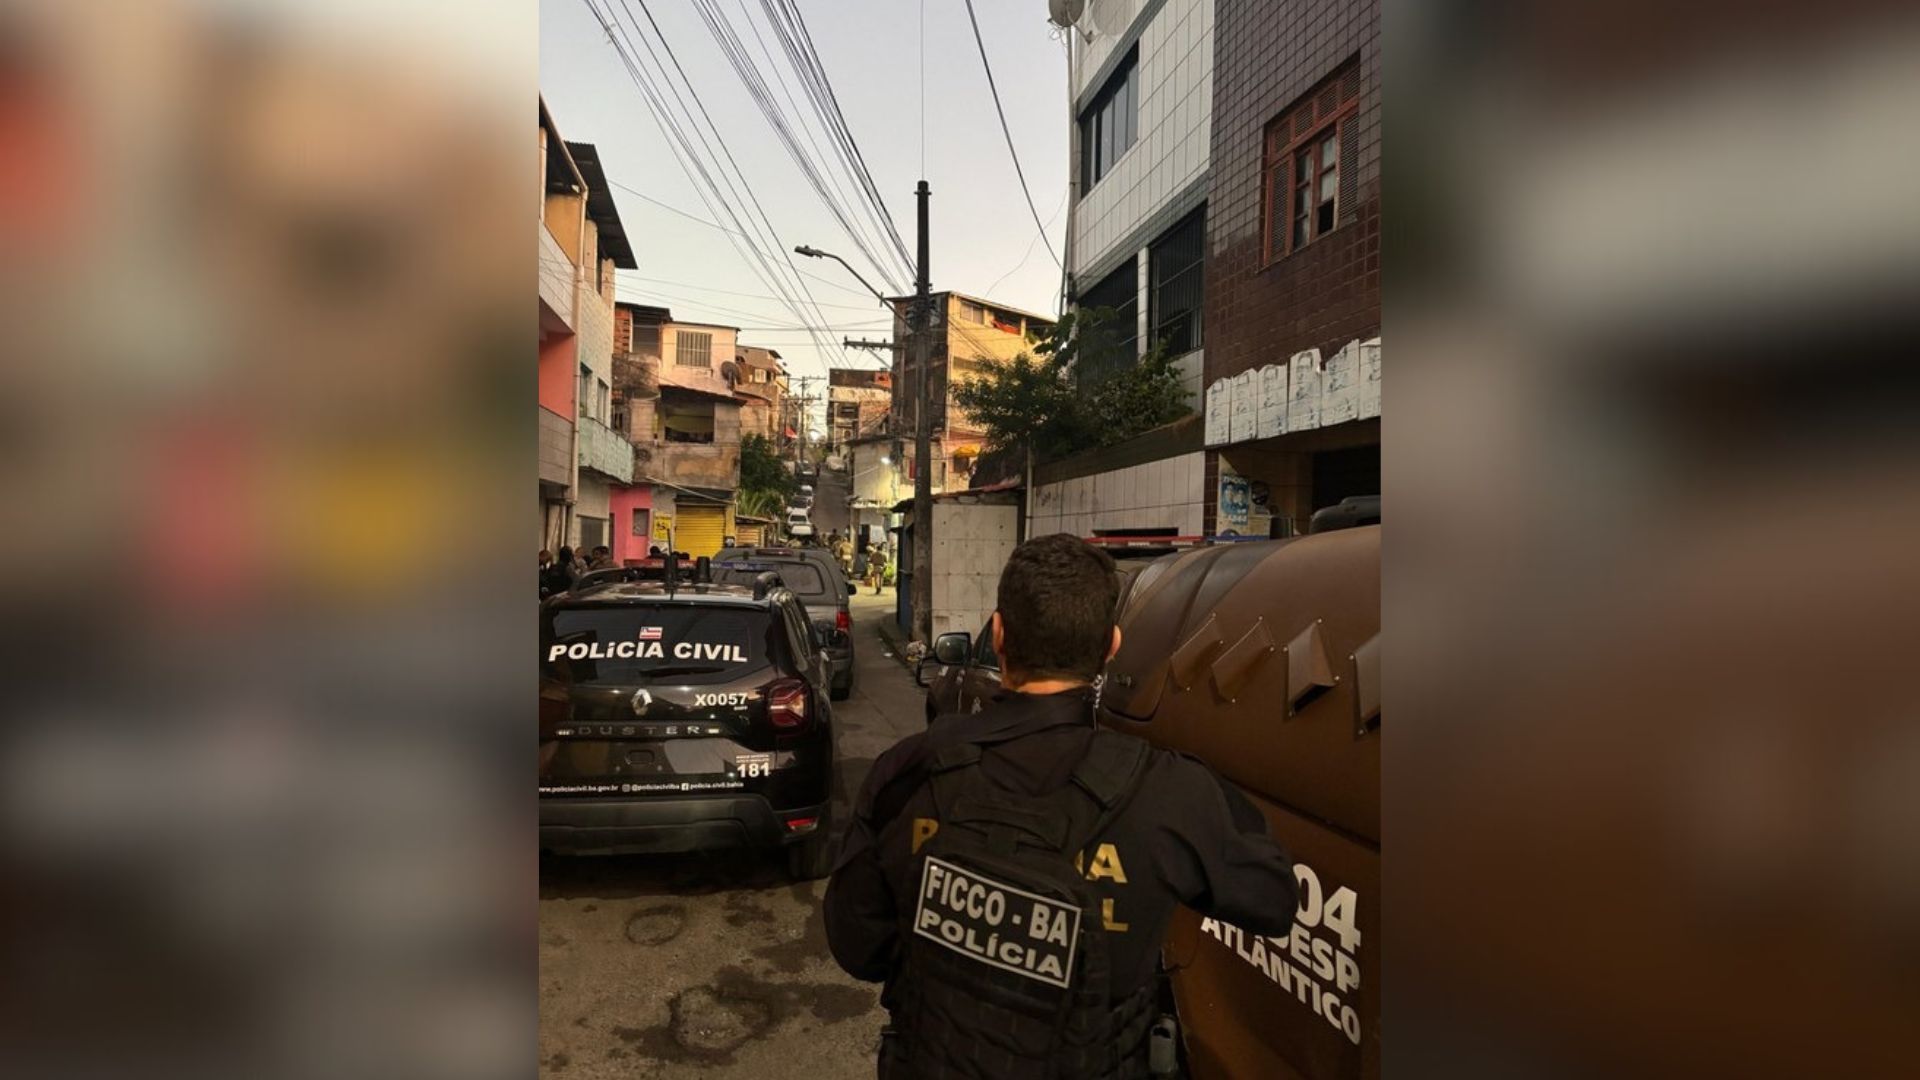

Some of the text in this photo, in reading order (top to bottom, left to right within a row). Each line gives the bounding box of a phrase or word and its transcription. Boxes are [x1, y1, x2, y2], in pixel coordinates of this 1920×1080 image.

[674, 642, 748, 662] CIVIL
[694, 692, 748, 706] X0057
[578, 725, 701, 736] DUSTER
[737, 762, 769, 778] 181
[926, 868, 1005, 926] FICCO
[1029, 903, 1069, 947] BA
[920, 907, 1064, 979] POLÍCIA
[1266, 923, 1361, 994] ESP
[1200, 915, 1361, 1046] ATLÂNTICO
